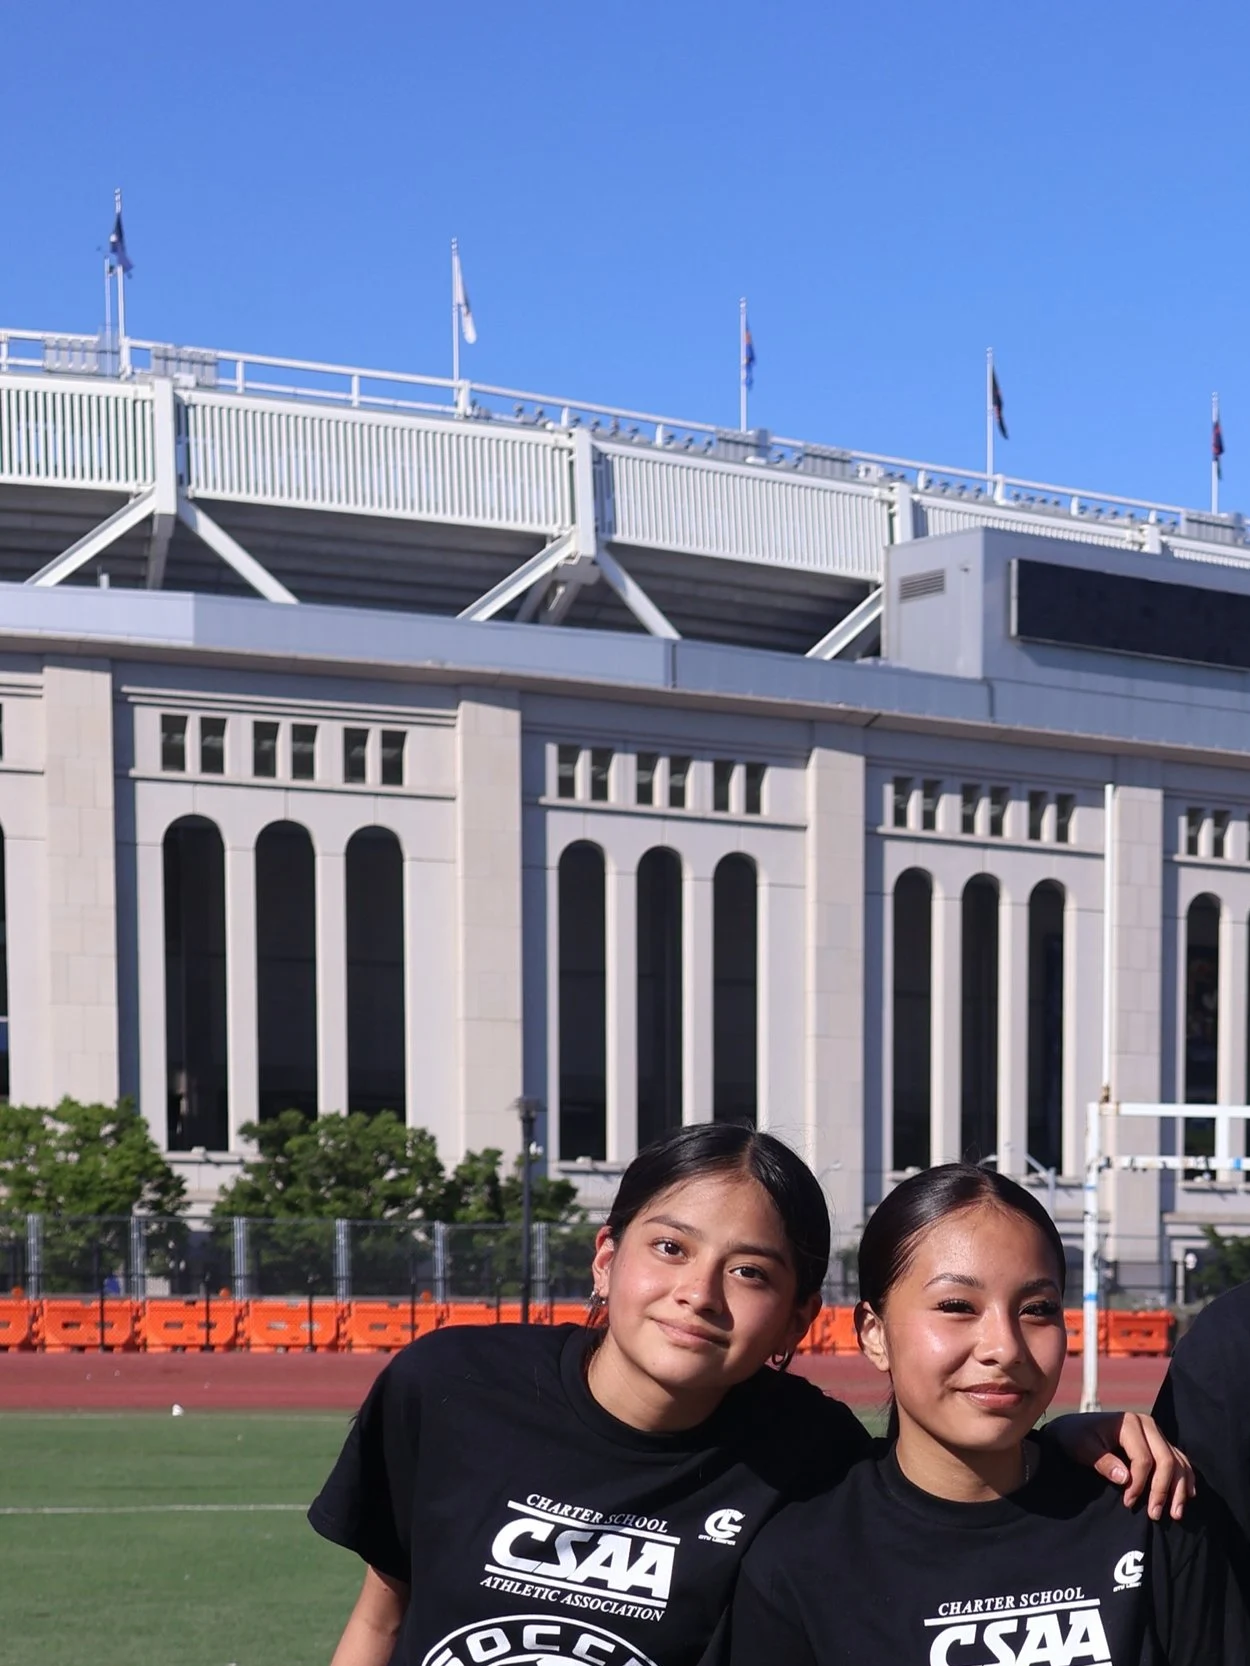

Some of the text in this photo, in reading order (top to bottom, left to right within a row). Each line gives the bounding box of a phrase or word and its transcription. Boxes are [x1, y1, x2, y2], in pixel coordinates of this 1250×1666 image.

[526, 1494, 668, 1533] CHARTER SCHOOL
[492, 1518, 675, 1599] CSAA
[480, 1576, 665, 1621] ATHLETIC ASSOCIATION
[938, 1587, 1085, 1616] CHARTER SCHOOL
